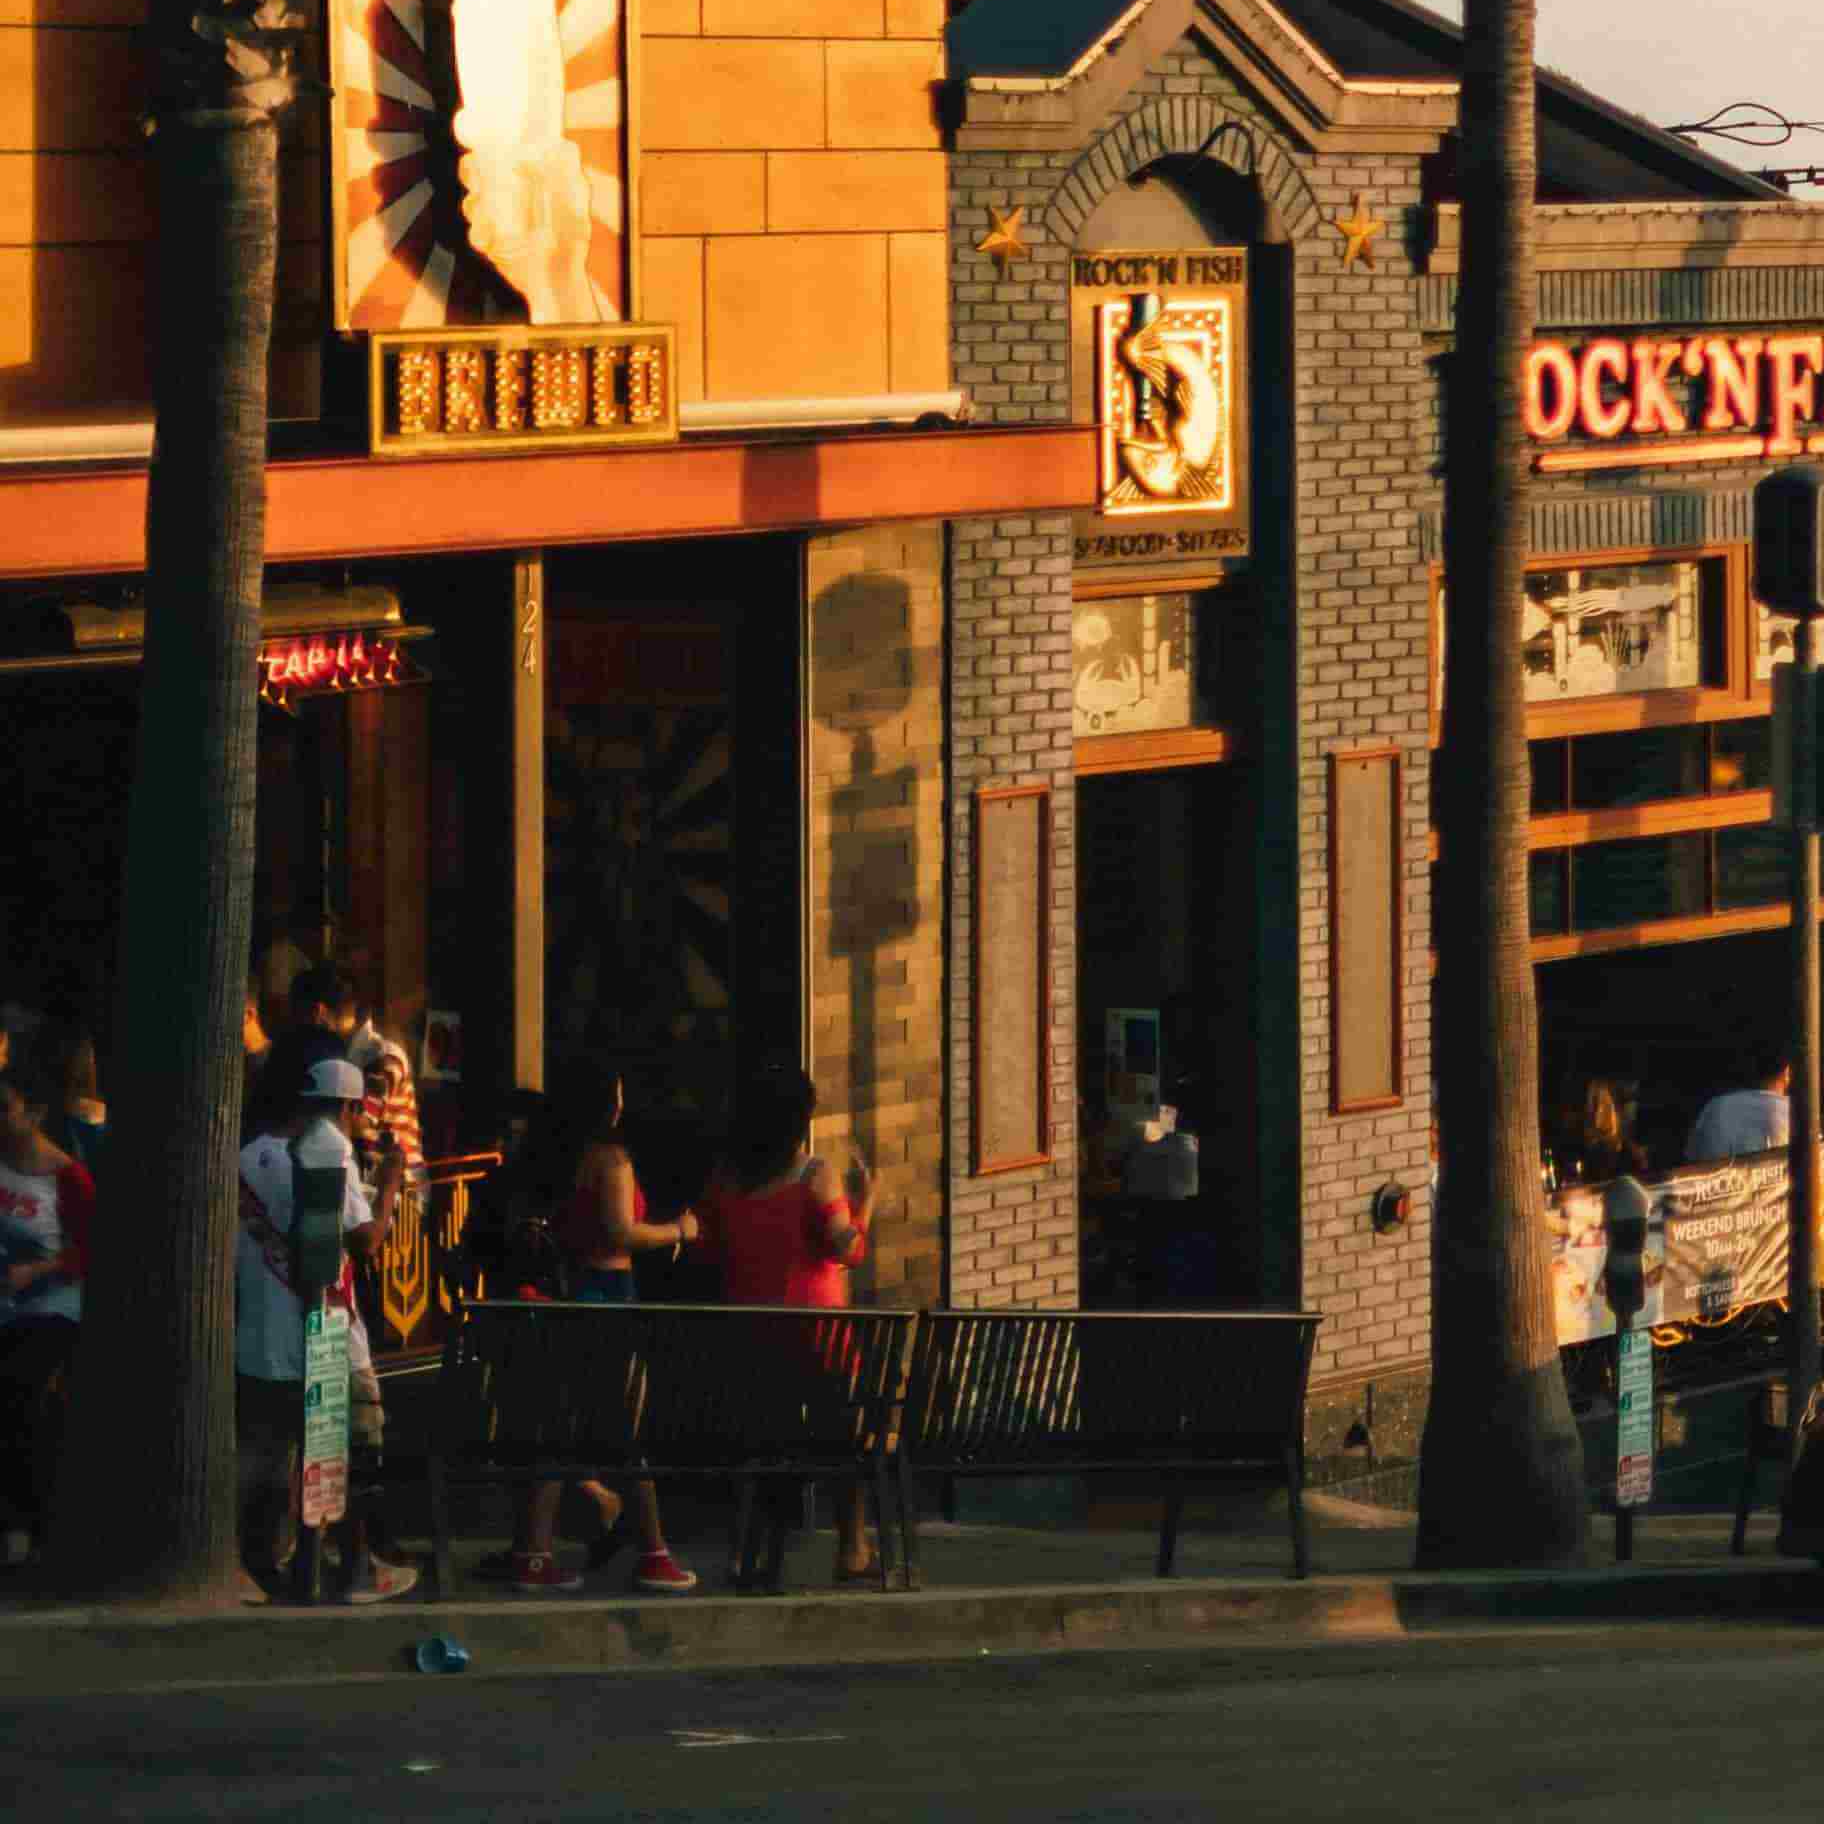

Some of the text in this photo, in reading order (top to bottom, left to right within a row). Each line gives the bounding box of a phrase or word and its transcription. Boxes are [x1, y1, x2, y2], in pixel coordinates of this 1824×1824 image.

[1185, 256, 1244, 285] FISH
[399, 343, 662, 434] BREWCO
[1523, 333, 1763, 440] OCK'N
[1672, 1202, 1787, 1242] WEEKEND BRUNCH
